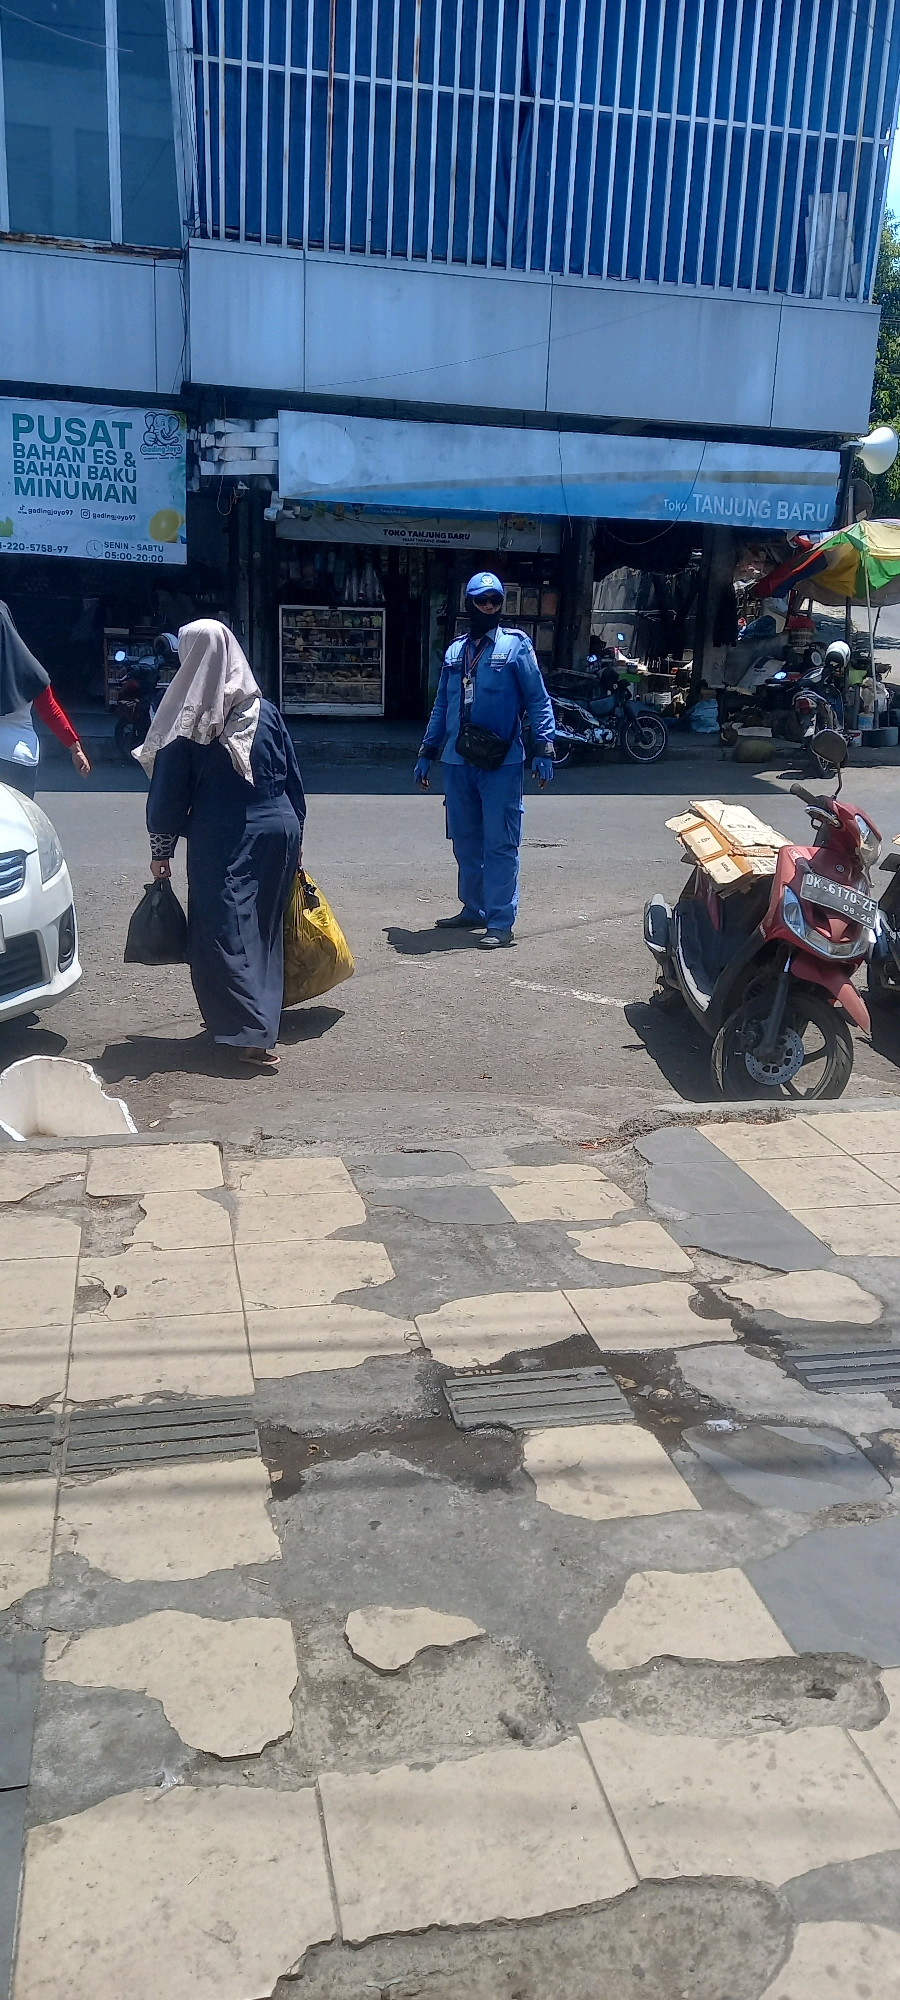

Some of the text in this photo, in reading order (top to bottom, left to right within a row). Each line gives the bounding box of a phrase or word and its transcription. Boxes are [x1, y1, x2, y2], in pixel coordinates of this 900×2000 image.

[12, 412, 133, 450] PUSAT
[13, 442, 137, 468] BAHAN ES &
[13, 459, 137, 484] BAHAN BAKU
[14, 477, 137, 505] MINUMAN
[27, 506, 74, 517] gadingjaya97
[663, 493, 829, 522] Toko TANJUNG BARU
[104, 541, 129, 551] SENIN
[136, 543, 164, 553] SABTU
[383, 528, 406, 538] TOKO
[407, 530, 447, 540] TANJUNG
[447, 532, 471, 541] BARU
[104, 551, 164, 563] 05:00-20:00
[805, 873, 877, 912] DK 6170 ZF
